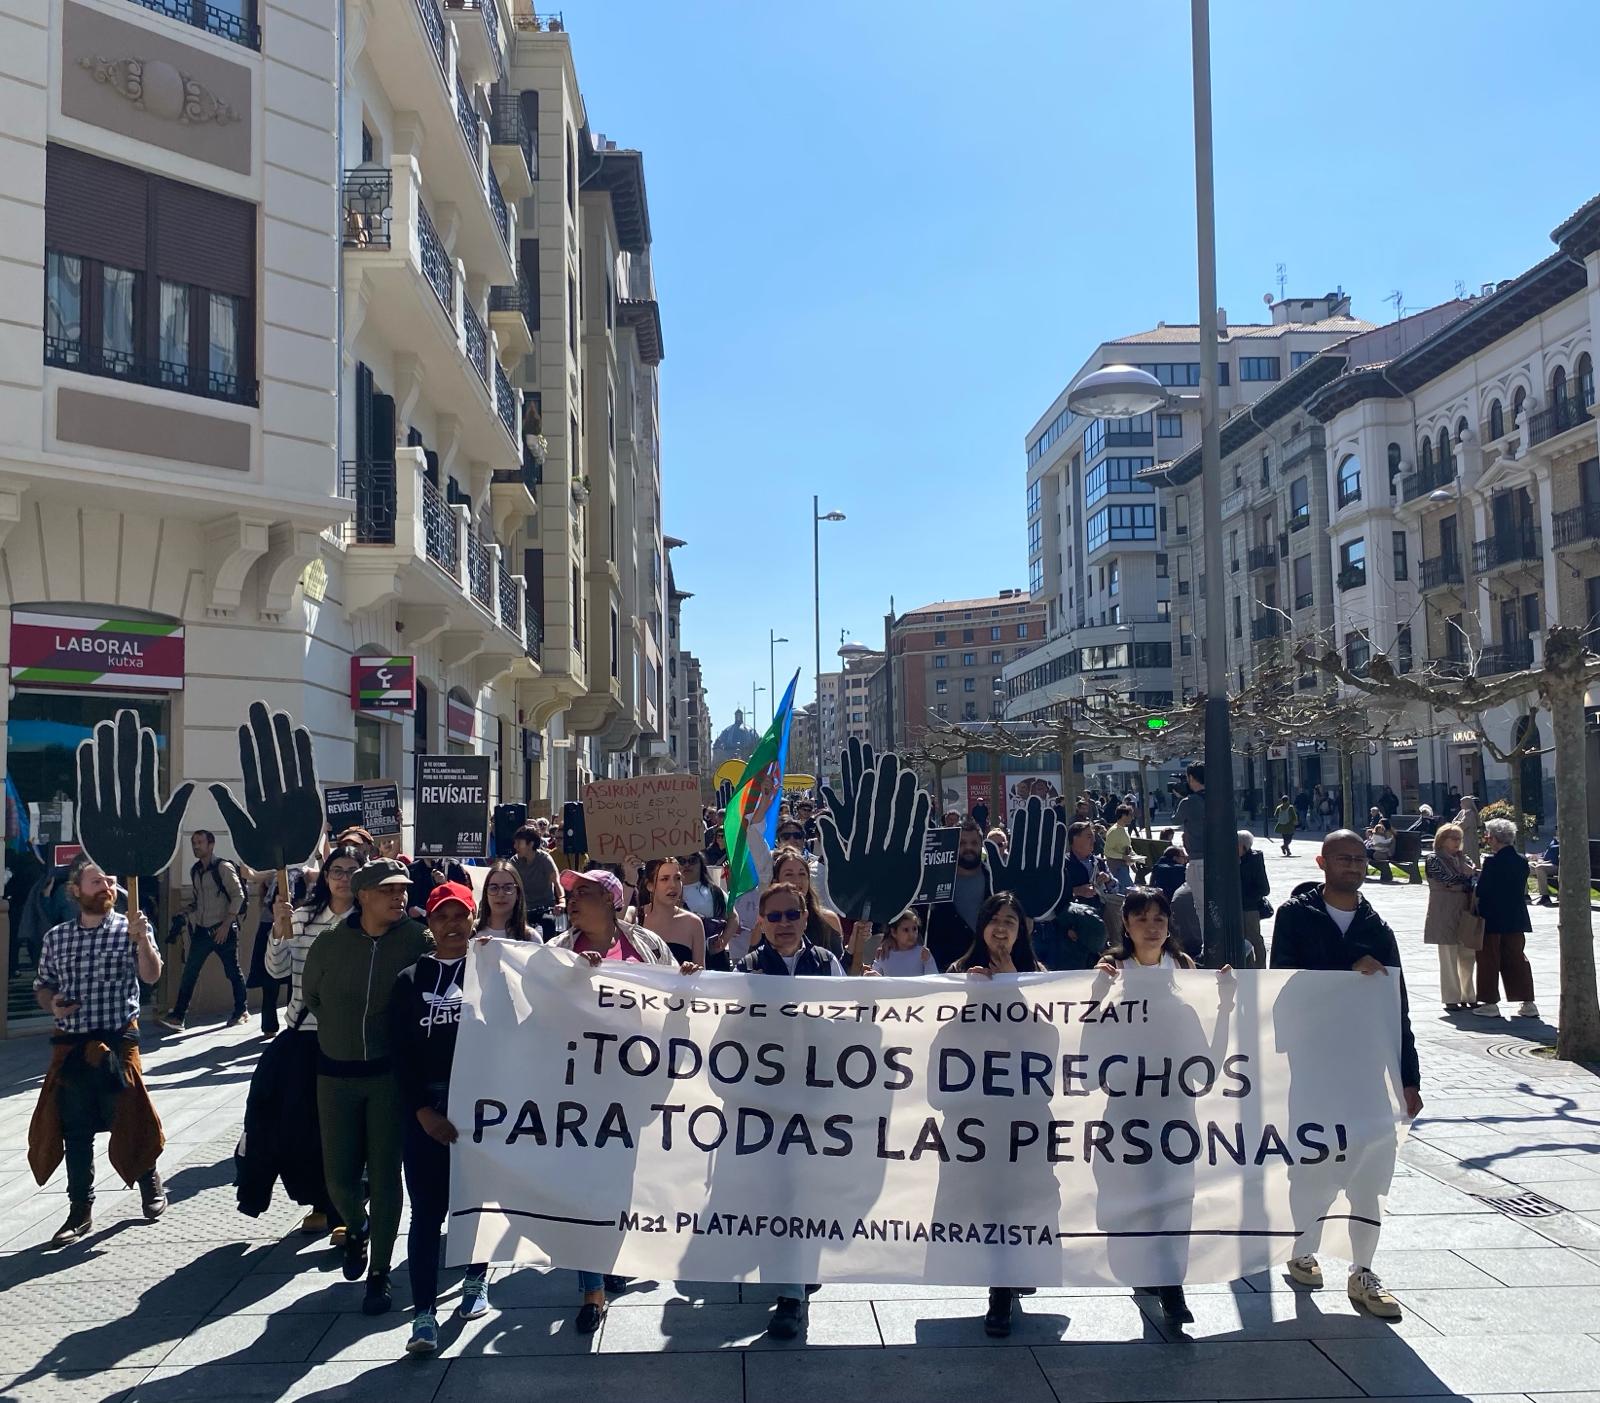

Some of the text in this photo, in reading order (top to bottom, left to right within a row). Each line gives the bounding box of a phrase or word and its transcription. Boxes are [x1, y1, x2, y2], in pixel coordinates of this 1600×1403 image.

[55, 635, 144, 657] LABORAL
[108, 656, 144, 668] kutxa
[421, 783, 486, 804] REVÍSATE.
[614, 808, 688, 827] NUESTRO
[457, 831, 483, 843] #21M
[923, 849, 956, 866] EVÍSATE.
[779, 1003, 925, 1023] GUZTIAK
[936, 999, 1149, 1024] DENONTZAT!
[565, 1031, 1252, 1098] ¡TODOS LOS DERECHOS
[472, 1099, 1348, 1166] PARA TODAS LAS PERSONAS!
[618, 1210, 1052, 1245] M21 PLATAFORMA ANTIARRAZISTA
